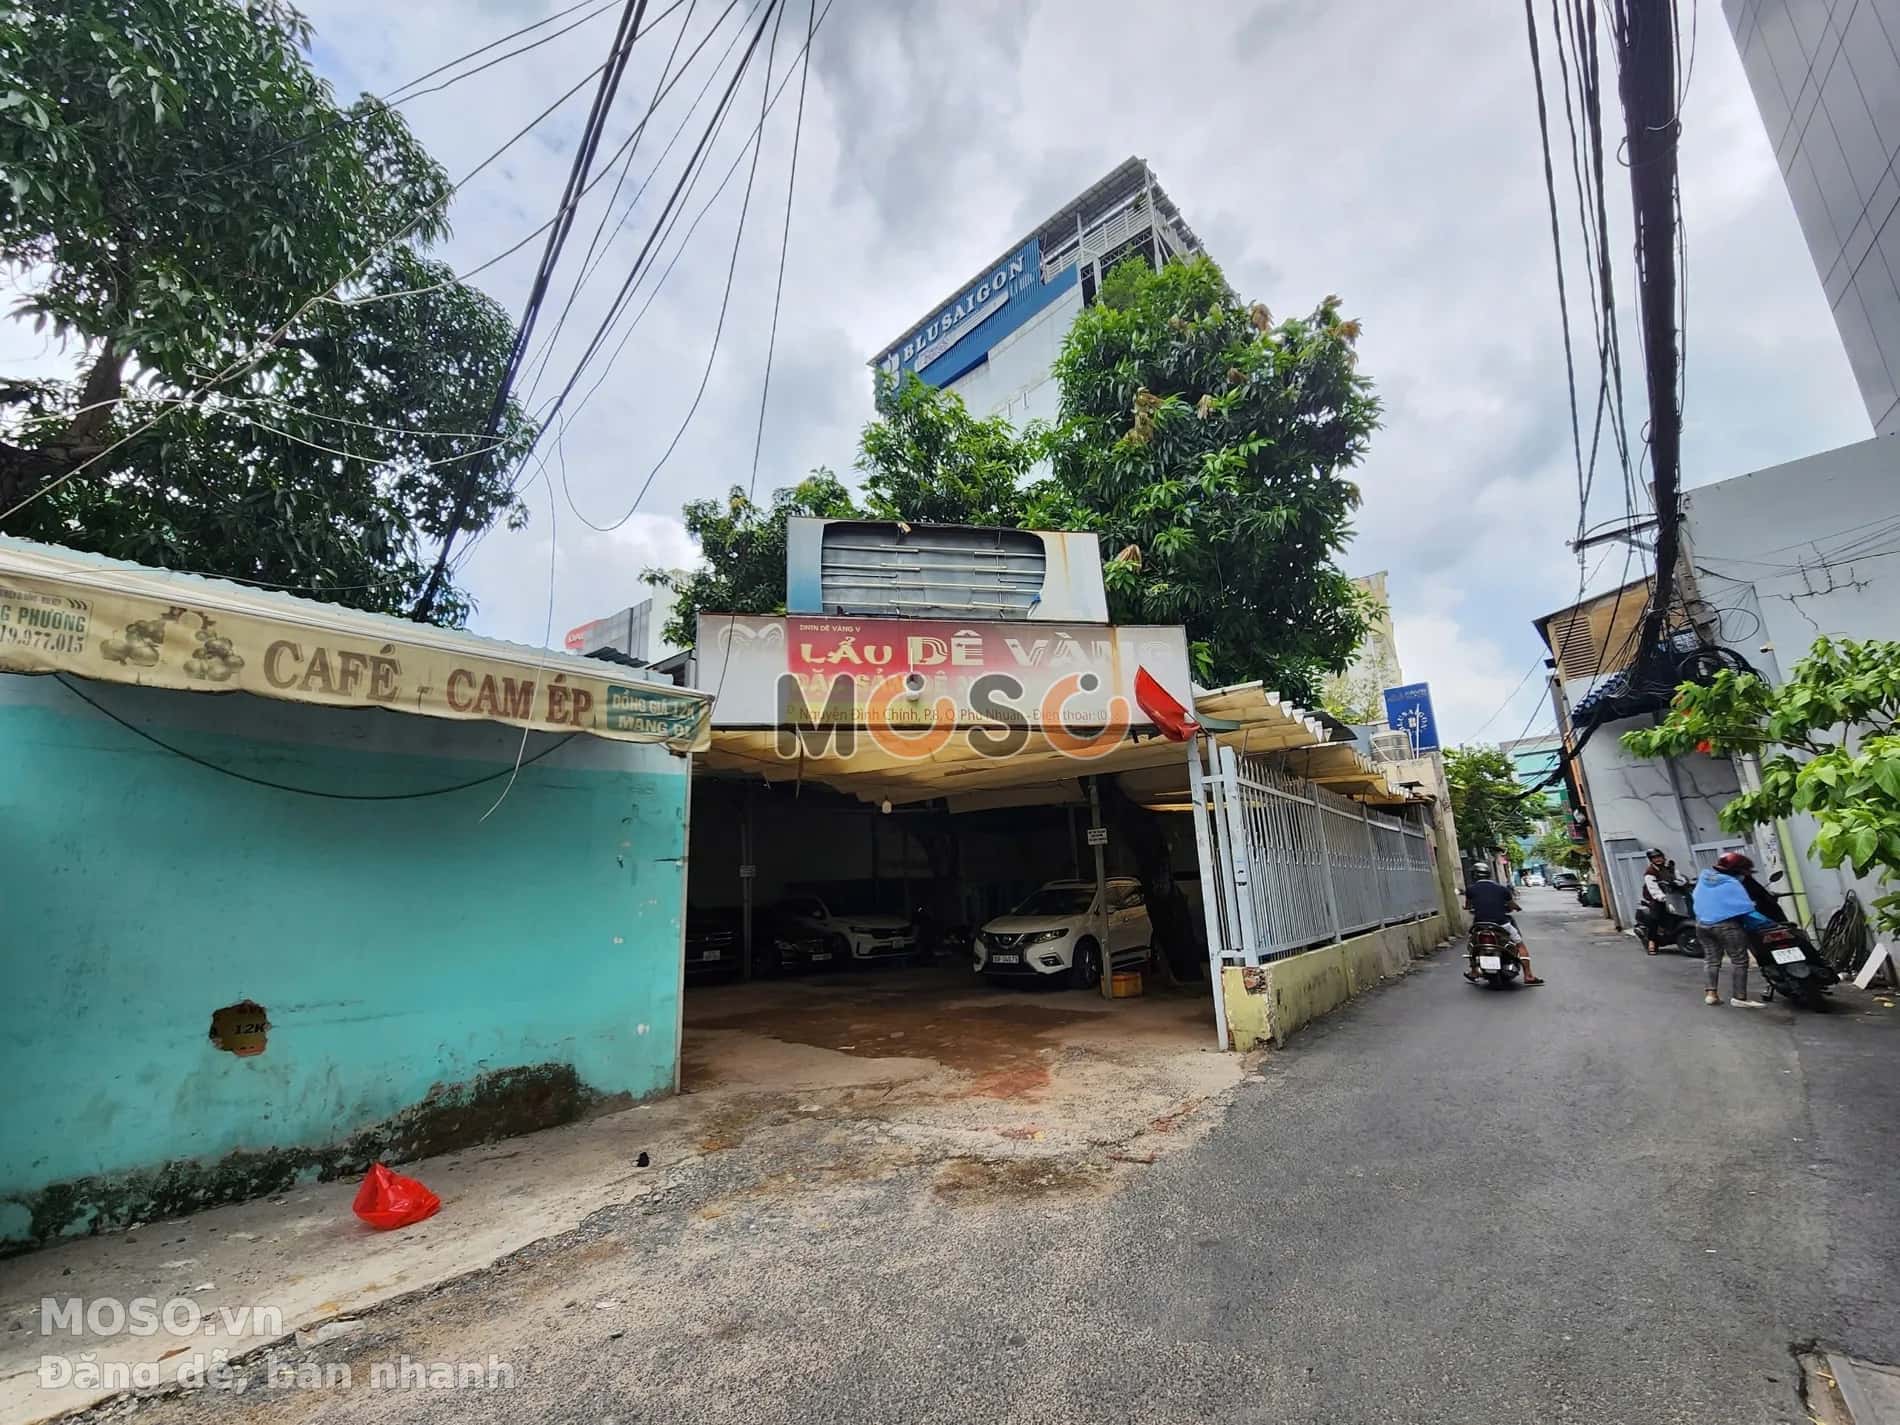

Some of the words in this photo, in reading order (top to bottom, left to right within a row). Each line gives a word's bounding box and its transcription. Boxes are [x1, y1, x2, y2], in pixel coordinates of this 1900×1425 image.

[17, 606, 87, 633] PHƯƠNG
[800, 636, 893, 665] LẨU
[907, 629, 984, 665] DÊ
[263, 639, 402, 703] CAFÉ
[446, 668, 536, 720] CAM
[545, 673, 594, 727] ÉP
[618, 715, 669, 735] MANG
